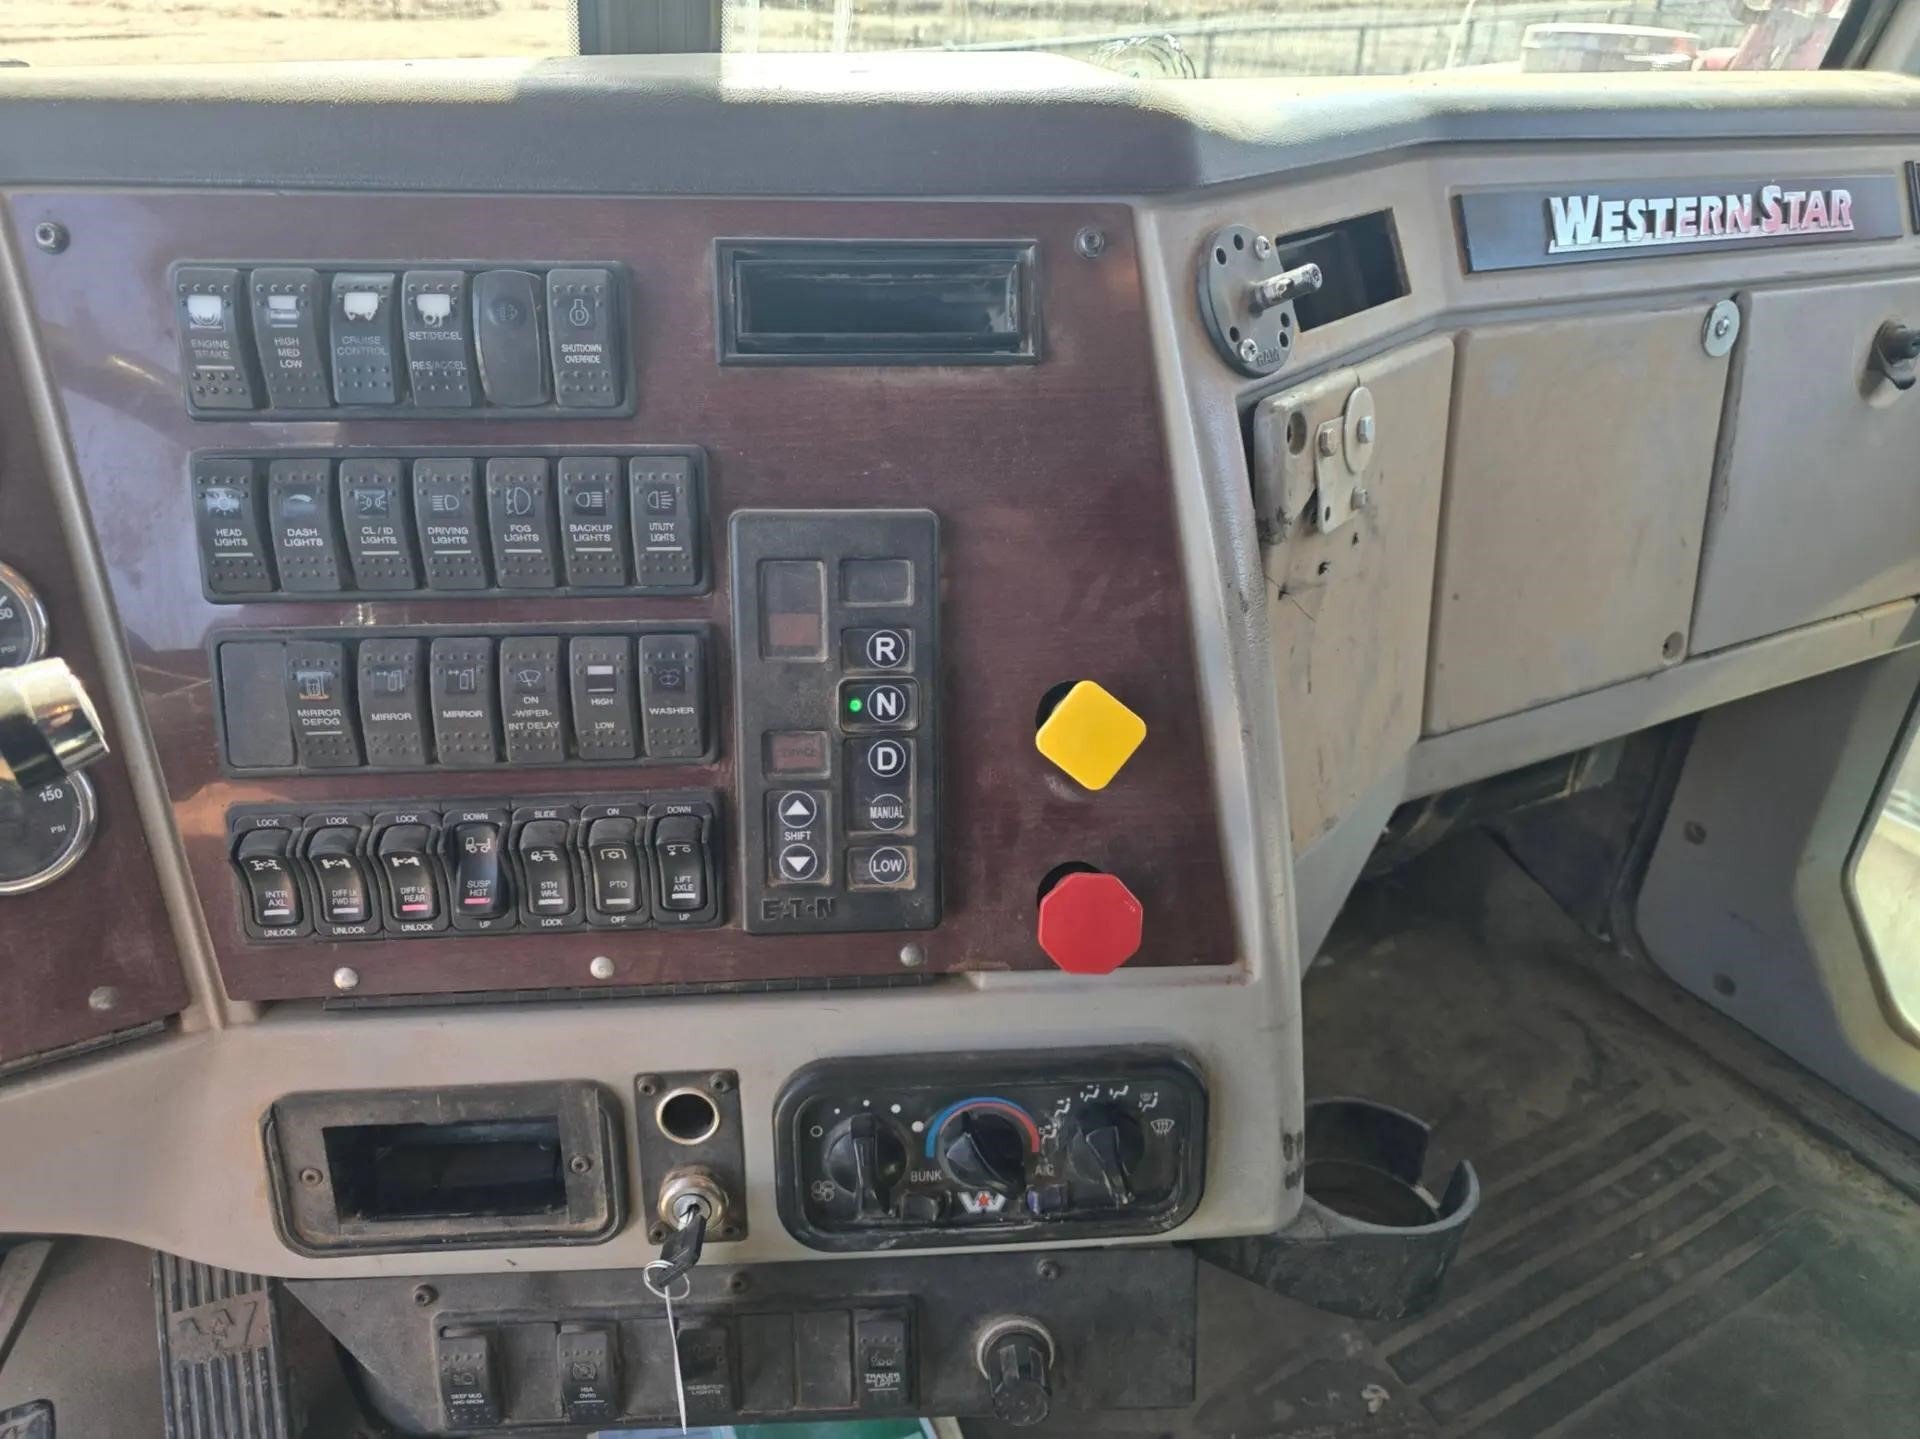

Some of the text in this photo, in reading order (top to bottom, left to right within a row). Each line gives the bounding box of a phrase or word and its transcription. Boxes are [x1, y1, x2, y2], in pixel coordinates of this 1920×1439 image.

[1549, 185, 1853, 247] WESTERN STAR
[190, 338, 230, 350] ENGINE
[273, 336, 300, 347] HIGH
[342, 335, 381, 345] CRUISE
[277, 347, 301, 358] MED
[337, 345, 388, 356] CONTROL
[561, 343, 602, 354] SHUTDOWN
[564, 353, 602, 364] OVERRIDE
[279, 359, 304, 369] LOW
[510, 524, 533, 534] FOG
[569, 524, 613, 534] BACKUP
[649, 522, 674, 531] UTILITY
[215, 528, 243, 538] HEAD
[287, 528, 318, 538] DASH
[427, 527, 469, 537] DRIVING
[650, 532, 676, 542] LIGHTS
[214, 538, 248, 547] LIGHTS
[283, 538, 323, 547] LIGHTS
[360, 536, 397, 545] LIGHTS
[431, 536, 468, 545] LIGHTS
[504, 533, 540, 543] LIGHTS
[573, 533, 611, 542] LIGHTS
[876, 636, 896, 662] R
[523, 695, 540, 705] ON
[591, 696, 614, 706] HIGH
[877, 692, 896, 718] N
[297, 707, 341, 718] MIRROR
[442, 709, 484, 720] MIRROR
[648, 705, 695, 716] WASHER
[371, 711, 412, 722] MIRROR
[302, 717, 340, 727] DEFOG
[508, 720, 560, 731] INT DELAY
[594, 720, 615, 730] LOW
[877, 746, 898, 771] D
[38, 788, 63, 802] 150
[533, 809, 558, 819] SLIDE
[606, 806, 622, 816] ON
[666, 804, 693, 815] DOWN
[869, 805, 905, 820] MANUAL
[325, 815, 350, 826] LOCK
[395, 813, 419, 824] LOCK
[462, 811, 490, 821] DOWN
[256, 817, 281, 828] LOCK
[784, 830, 812, 842] SHIFT
[873, 857, 903, 873] LOW
[466, 879, 492, 890] SUSP
[608, 880, 629, 890] PTO
[674, 875, 693, 885] LIFT
[400, 887, 417, 897] DIFF
[468, 888, 489, 898] HGT
[673, 884, 694, 893] AXLE
[265, 891, 288, 900] INTR
[332, 889, 348, 899] DIFF
[540, 890, 561, 900] WHL
[268, 900, 287, 909] AXL
[404, 895, 427, 905] REAR
[610, 915, 626, 925] OFF
[678, 912, 690, 922] UP
[401, 922, 434, 934] UNLOCK
[479, 919, 491, 929] UP
[541, 918, 563, 928] LOCK
[264, 928, 297, 940] UNLOCK
[332, 925, 366, 937] UNLOCK
[1034, 1164, 1055, 1177] A/C
[910, 1170, 942, 1183] BUNK
